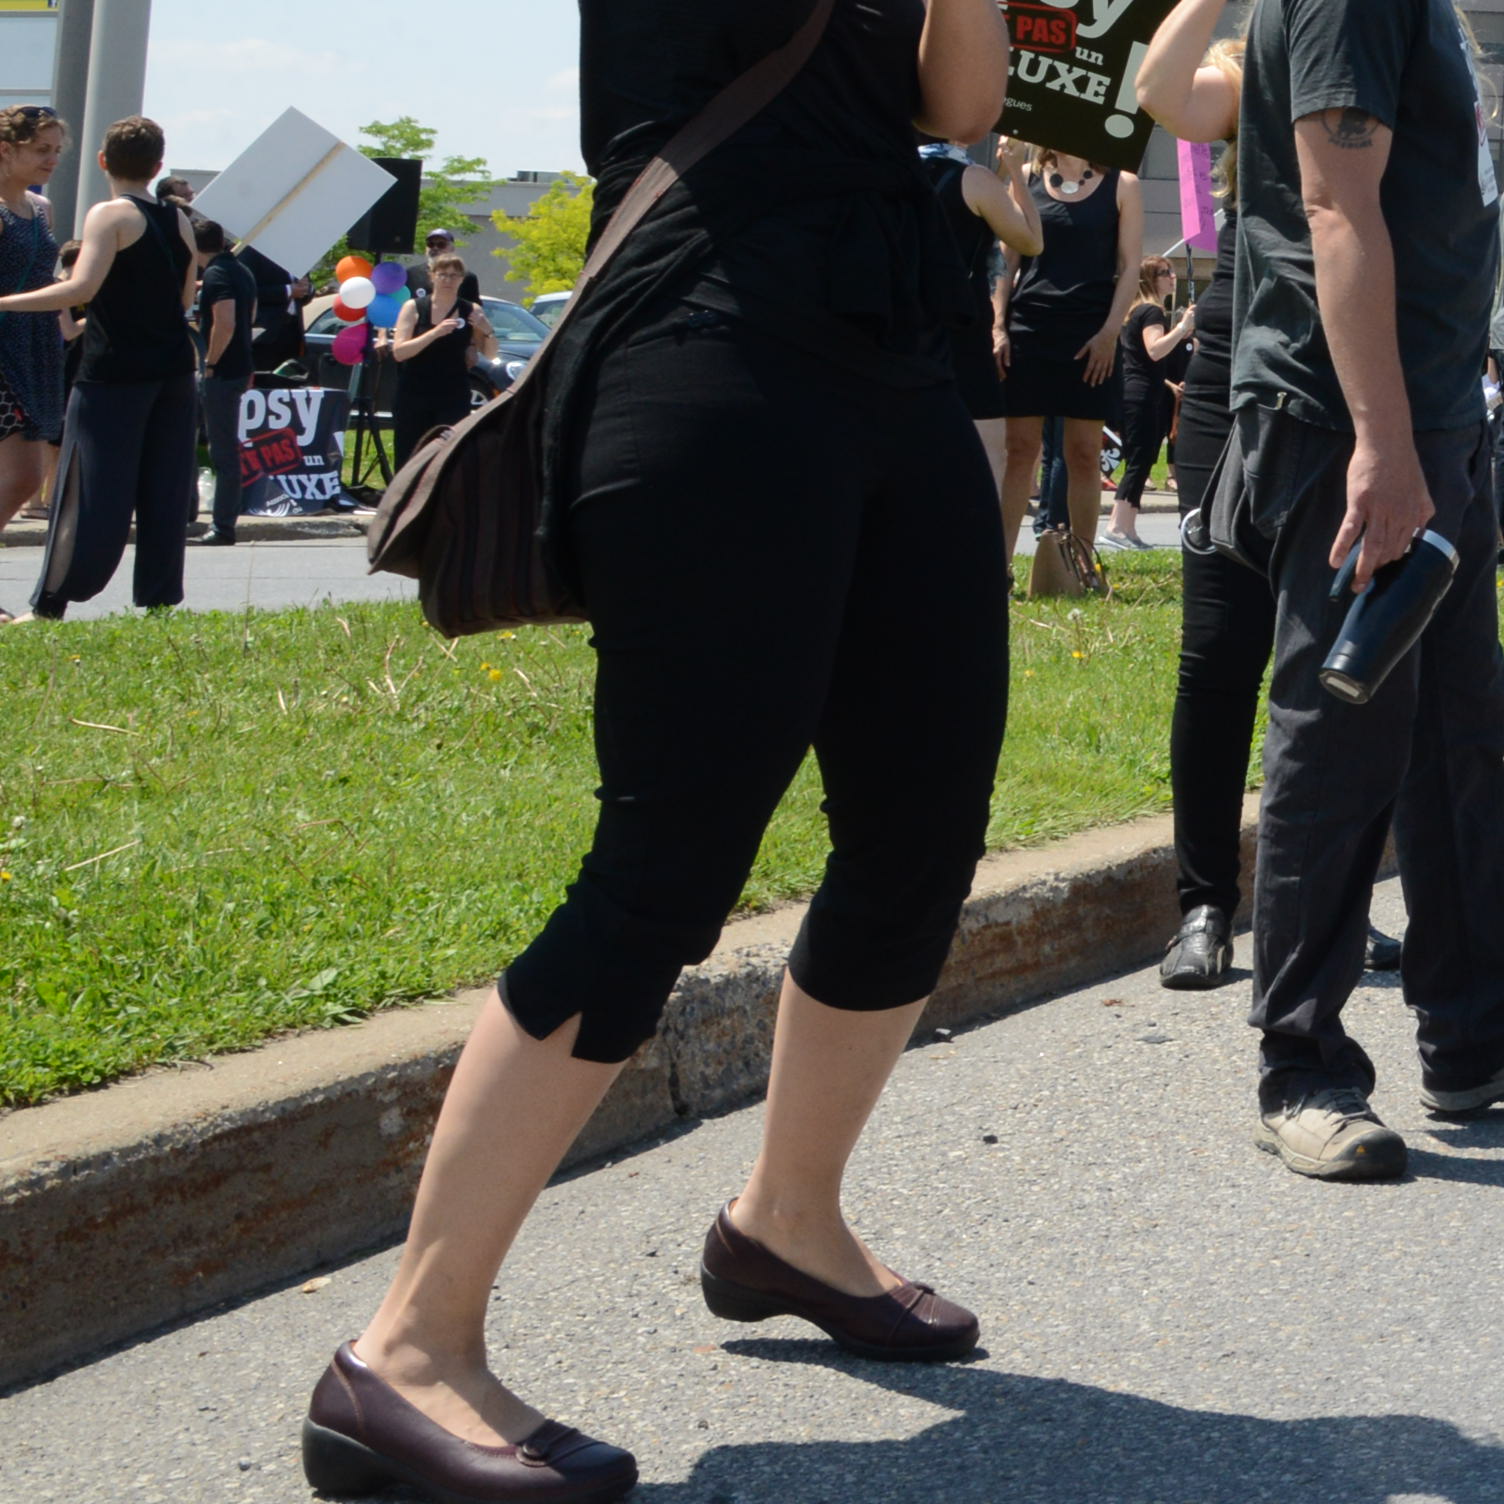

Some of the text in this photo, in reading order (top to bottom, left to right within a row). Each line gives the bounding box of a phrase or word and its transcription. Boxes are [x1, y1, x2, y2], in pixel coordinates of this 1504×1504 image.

[1016, 14, 1067, 46] PAS
[1075, 46, 1105, 66] un
[238, 389, 325, 447] psy
[303, 455, 325, 466] un
[273, 470, 341, 500] UXE
